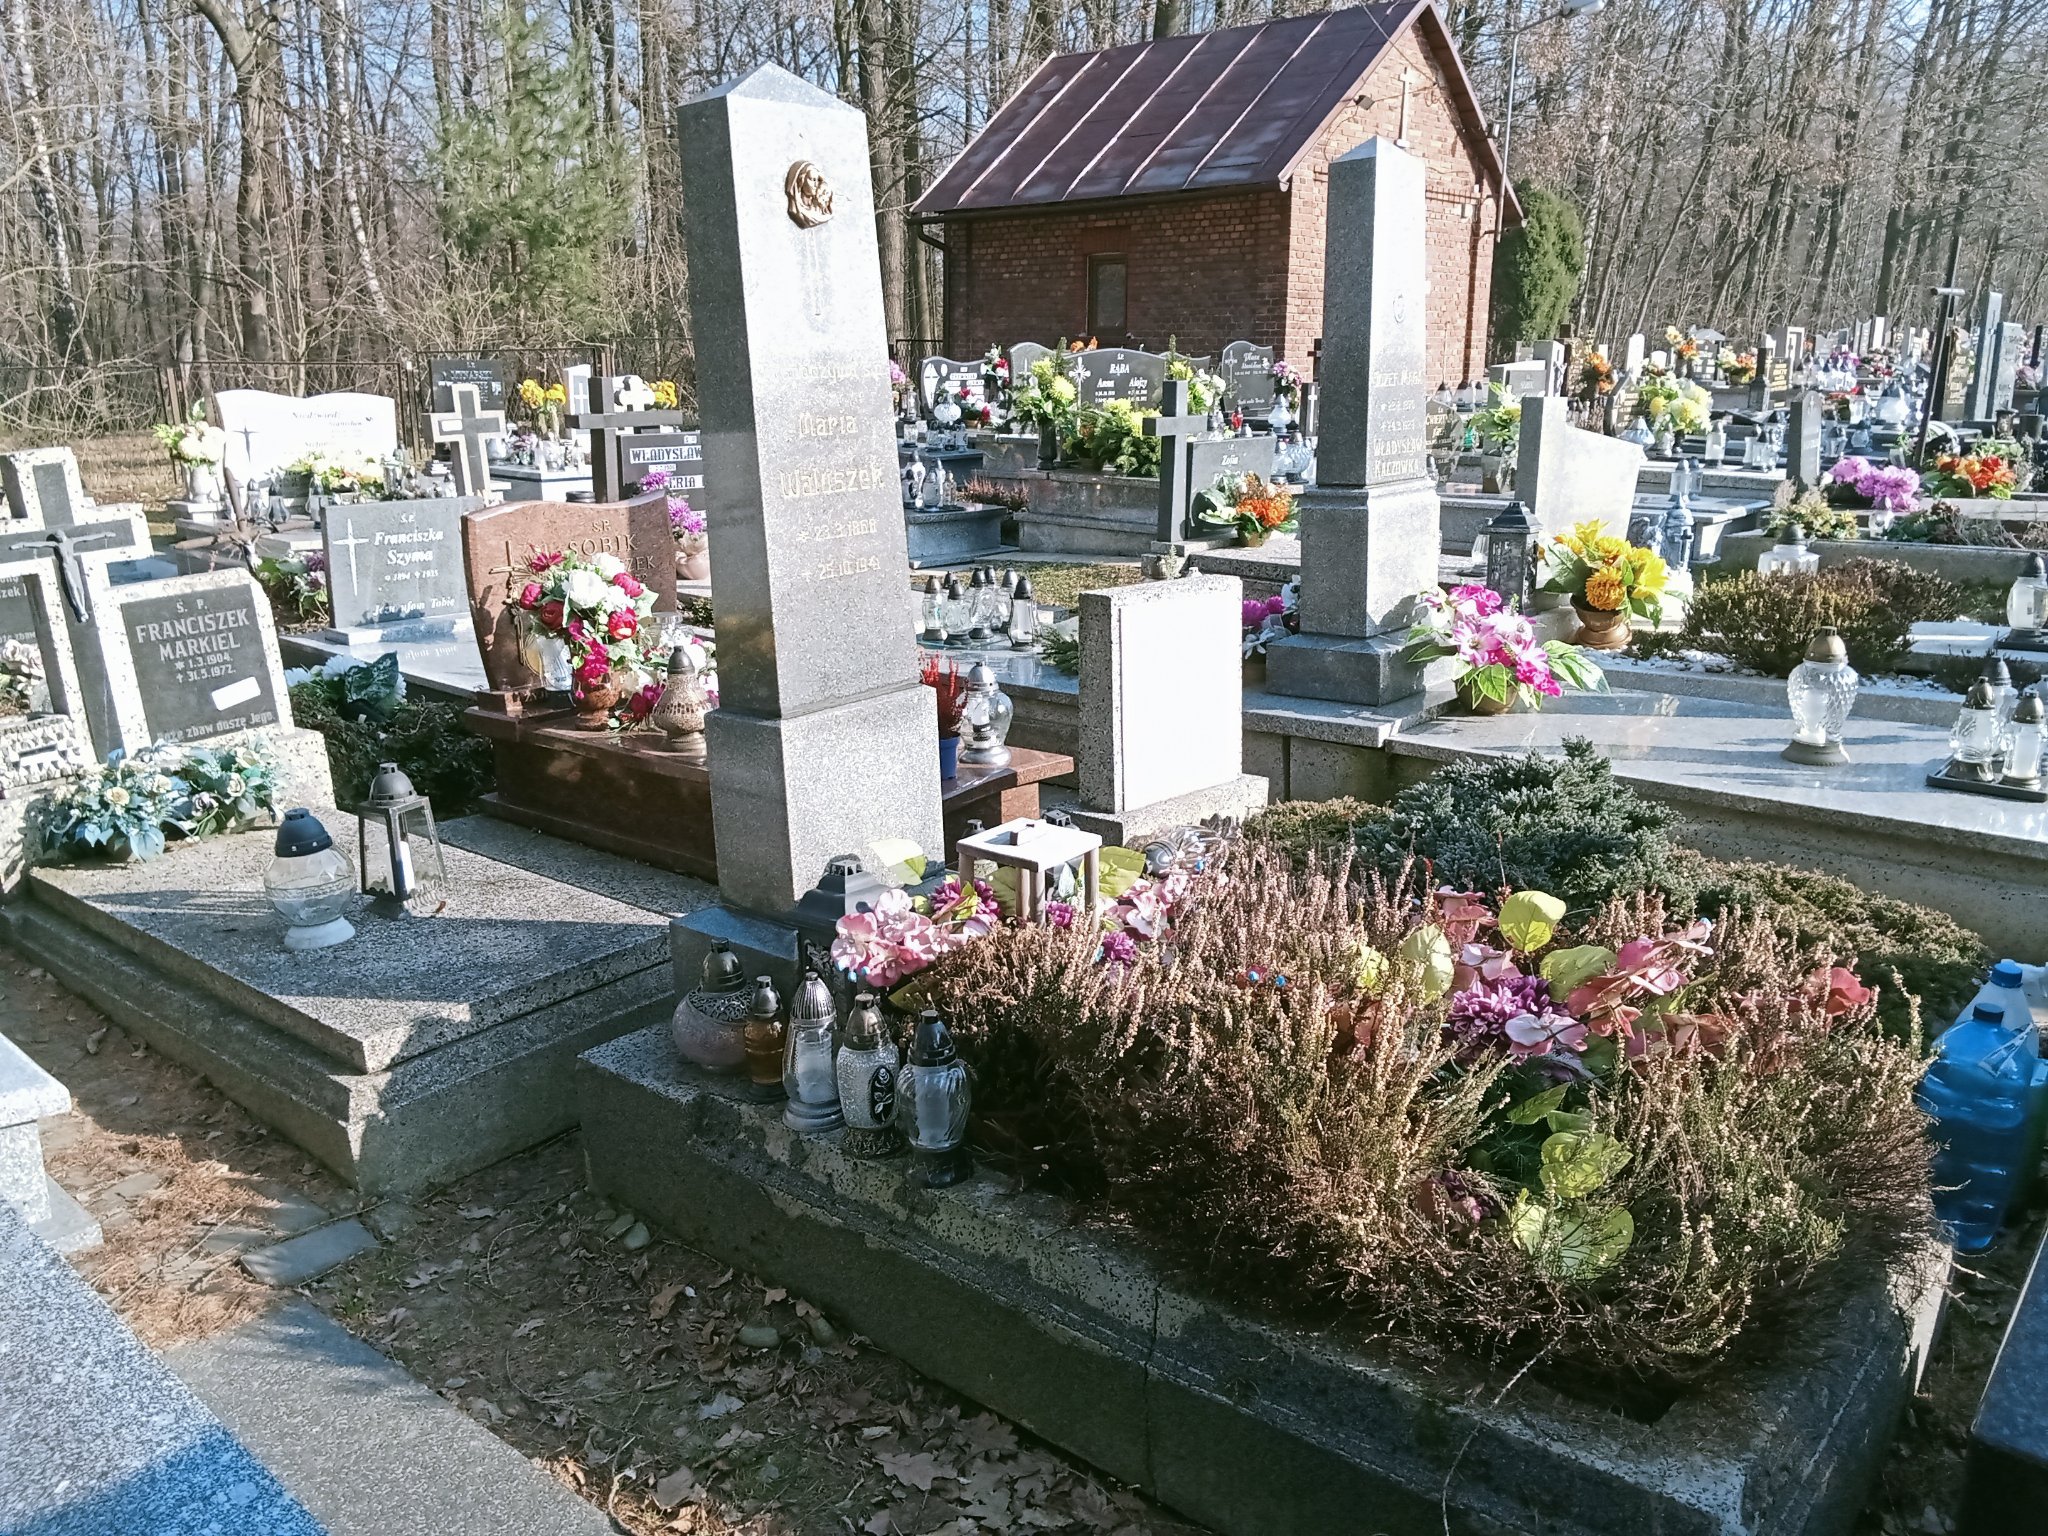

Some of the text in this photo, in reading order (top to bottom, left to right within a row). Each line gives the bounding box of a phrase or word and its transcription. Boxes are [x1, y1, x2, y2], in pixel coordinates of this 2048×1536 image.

[798, 412, 859, 438] Maria
[374, 527, 444, 546] Franciszka
[568, 533, 640, 558] SOBIK
[387, 549, 434, 566] Szyma
[430, 597, 456, 609] Tobie
[135, 608, 250, 643] FRANCISZEK
[159, 632, 241, 663] MARKIEL
[186, 722, 214, 738] zbaw
